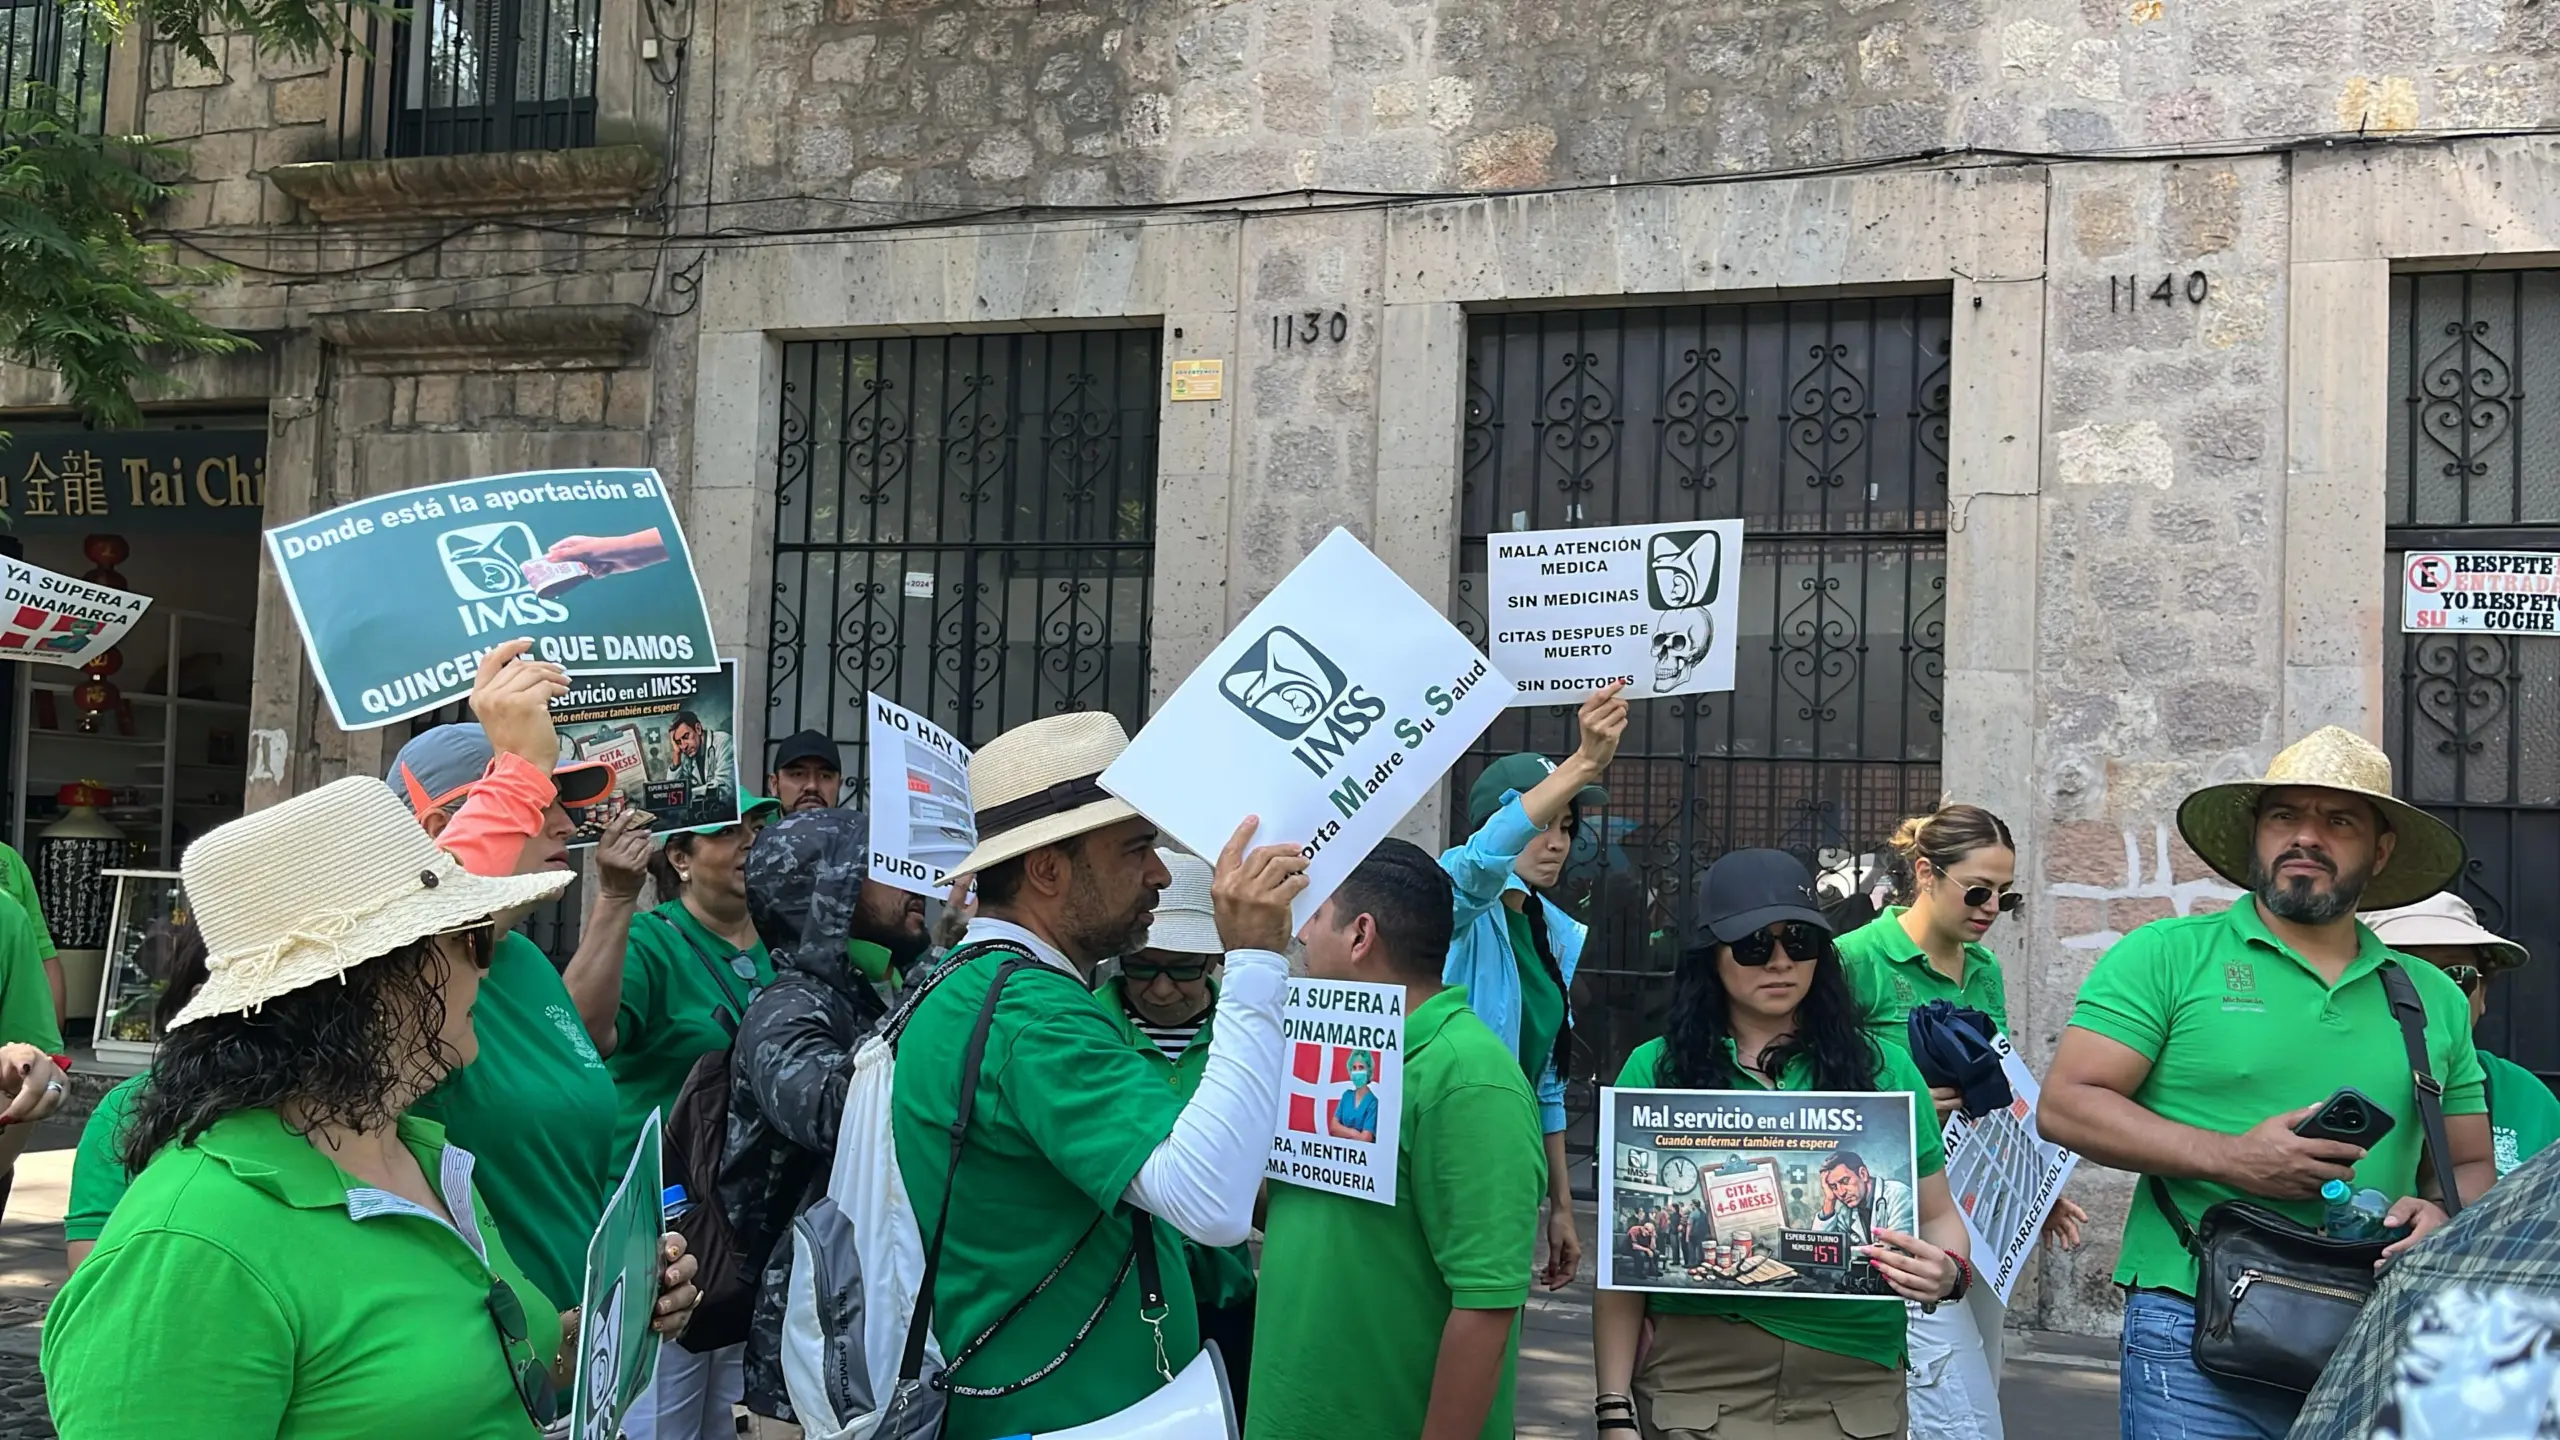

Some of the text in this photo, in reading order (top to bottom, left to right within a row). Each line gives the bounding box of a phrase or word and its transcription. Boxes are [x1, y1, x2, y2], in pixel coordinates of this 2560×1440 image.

[2110, 270, 2207, 313] 1140
[1273, 311, 1348, 350] 1130
[22, 450, 109, 516] 金龍
[121, 454, 264, 507] Tai Chi
[283, 477, 658, 560] Donde está la aportación al
[1499, 536, 1642, 559] MALA ATENCIÓN
[1541, 560, 1608, 576] MEDICA
[2455, 556, 2553, 575] RESPETE
[6, 564, 141, 611] YA SUPERA A
[1508, 589, 1639, 609] SIN MEDICINAS
[4, 588, 128, 625] DINAMARCA
[457, 593, 569, 637] IMSS
[2441, 592, 2560, 612] YO RESPET
[1499, 623, 1648, 643] CITAS DESPUES DE
[2417, 610, 2554, 630] SU COCHE
[540, 636, 598, 664] QUE
[603, 635, 694, 661] DAMOS
[1545, 644, 1612, 658] MUERTO
[550, 675, 697, 707] servicio en el IMSS:
[1517, 679, 1545, 692] SIN
[570, 709, 609, 721] enfermar
[609, 704, 642, 718] también
[643, 705, 652, 714] es
[652, 702, 681, 715] esperar
[878, 704, 953, 755] NO HAY
[1291, 685, 1386, 779] IMSS
[1328, 752, 1404, 820] Madre
[1394, 717, 1436, 750] Su
[1425, 659, 1487, 716] Salud
[600, 749, 626, 763] CITA:
[668, 791, 683, 805] 157
[873, 852, 926, 881] PURO
[1306, 988, 1383, 1014] SUPERA
[1389, 995, 1401, 1016] A
[1284, 1018, 1397, 1051] DINAMARCA
[1632, 1105, 1863, 1131] Mal servicio en el IMSS:
[1301, 1141, 1367, 1166] MENTIRA
[1655, 1134, 1839, 1150] Cuando enfermar también es esperar
[1265, 1158, 1375, 1193] MA PORQUERIA
[1627, 1167, 1649, 1178] IMSS
[1717, 1193, 1774, 1213] 4-6 MESES
[1725, 1183, 1758, 1198] CITA:
[1785, 1233, 1806, 1241] ESPERE
[1817, 1235, 1839, 1243] TURNO
[1993, 1255, 2013, 1297] PURO
[2010, 1164, 2062, 1257] PARACETAMOL
[1814, 1246, 1837, 1263] 157
[839, 1341, 854, 1409] ARMOUR
[1021, 1351, 1068, 1386] UNDER ARMOUR
[954, 1386, 1004, 1397] UNDER ARMOUR
